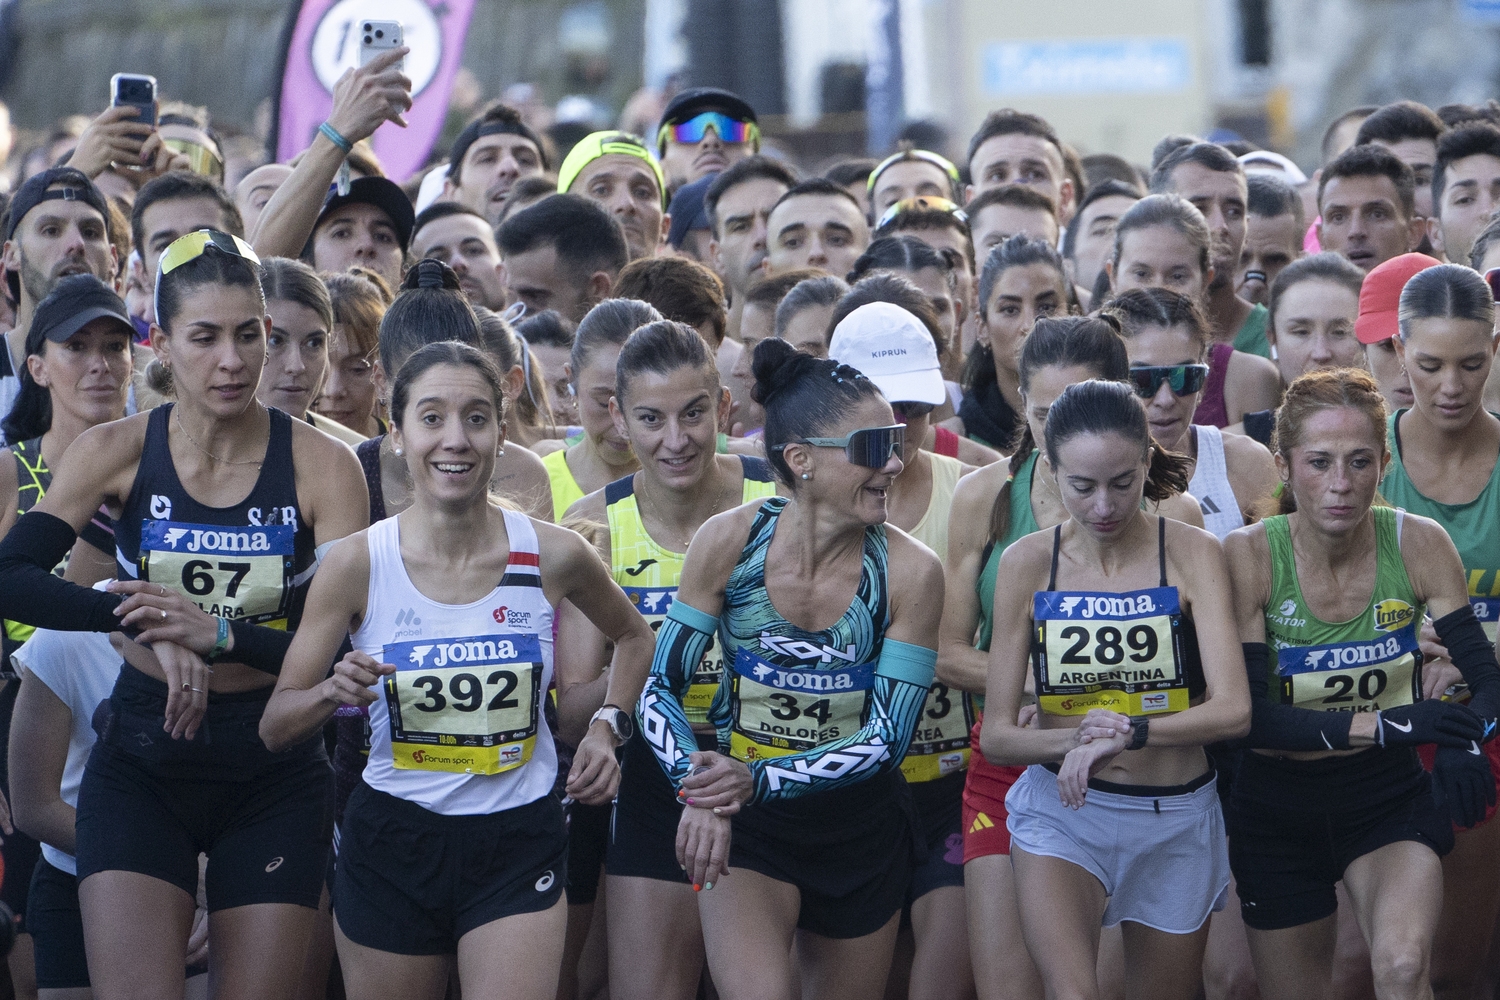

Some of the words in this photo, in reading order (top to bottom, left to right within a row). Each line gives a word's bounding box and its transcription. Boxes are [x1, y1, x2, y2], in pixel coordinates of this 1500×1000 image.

[871, 348, 907, 359] KIPRUN
[181, 559, 251, 599] 67
[192, 602, 245, 619] LARA
[1059, 624, 1159, 666] 289
[1059, 668, 1165, 685] ARGENTINA
[1322, 668, 1388, 704] 20
[412, 670, 519, 713] 392
[768, 692, 833, 725] 34
[759, 721, 840, 744] DOLORES
[452, 757, 474, 765] sport
